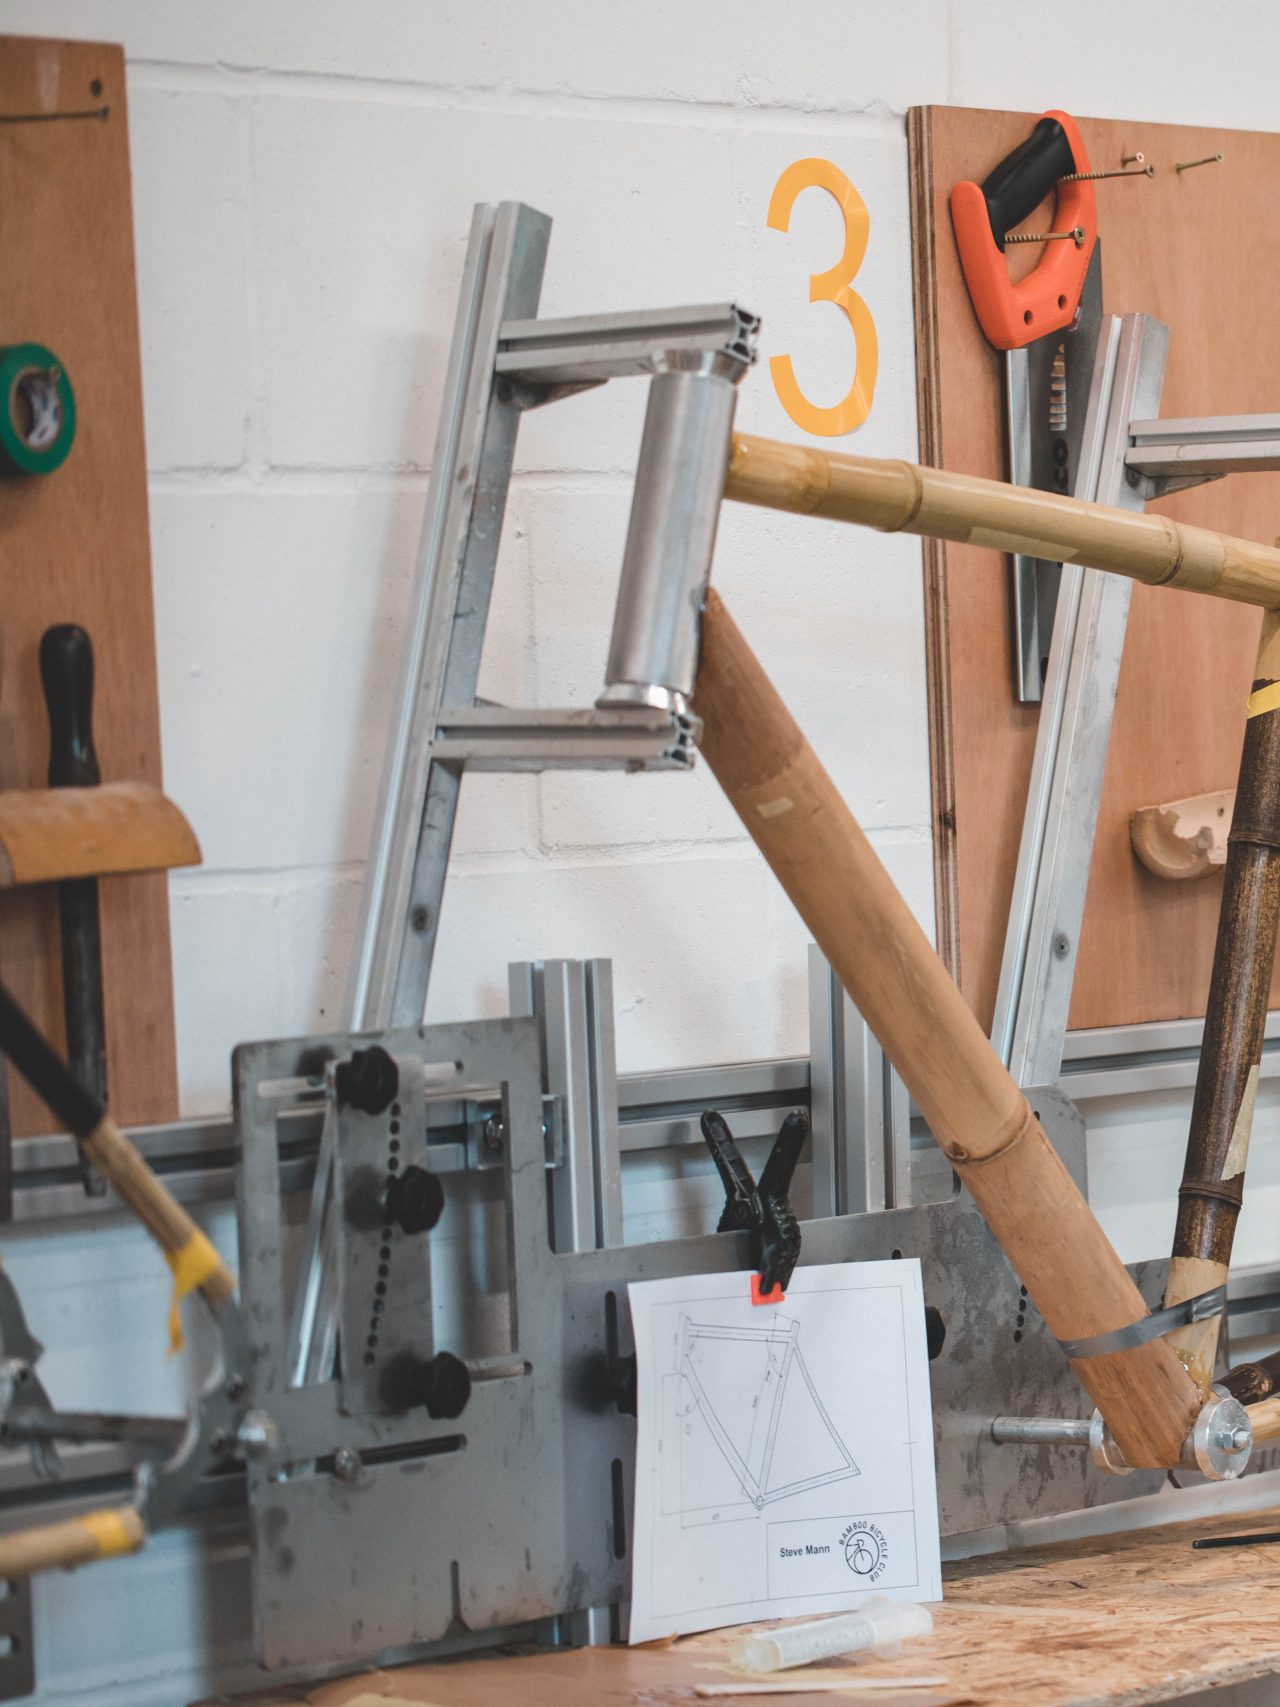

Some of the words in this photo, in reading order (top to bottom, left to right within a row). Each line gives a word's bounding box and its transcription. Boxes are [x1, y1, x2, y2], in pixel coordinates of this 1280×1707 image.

[767, 157, 879, 437] 3
[839, 1521, 867, 1546] BAMBOO
[869, 1524, 888, 1559] BICYCLE
[780, 1547, 803, 1558] Steve
[805, 1544, 830, 1555] Mann
[869, 1563, 886, 1582] CLUB
